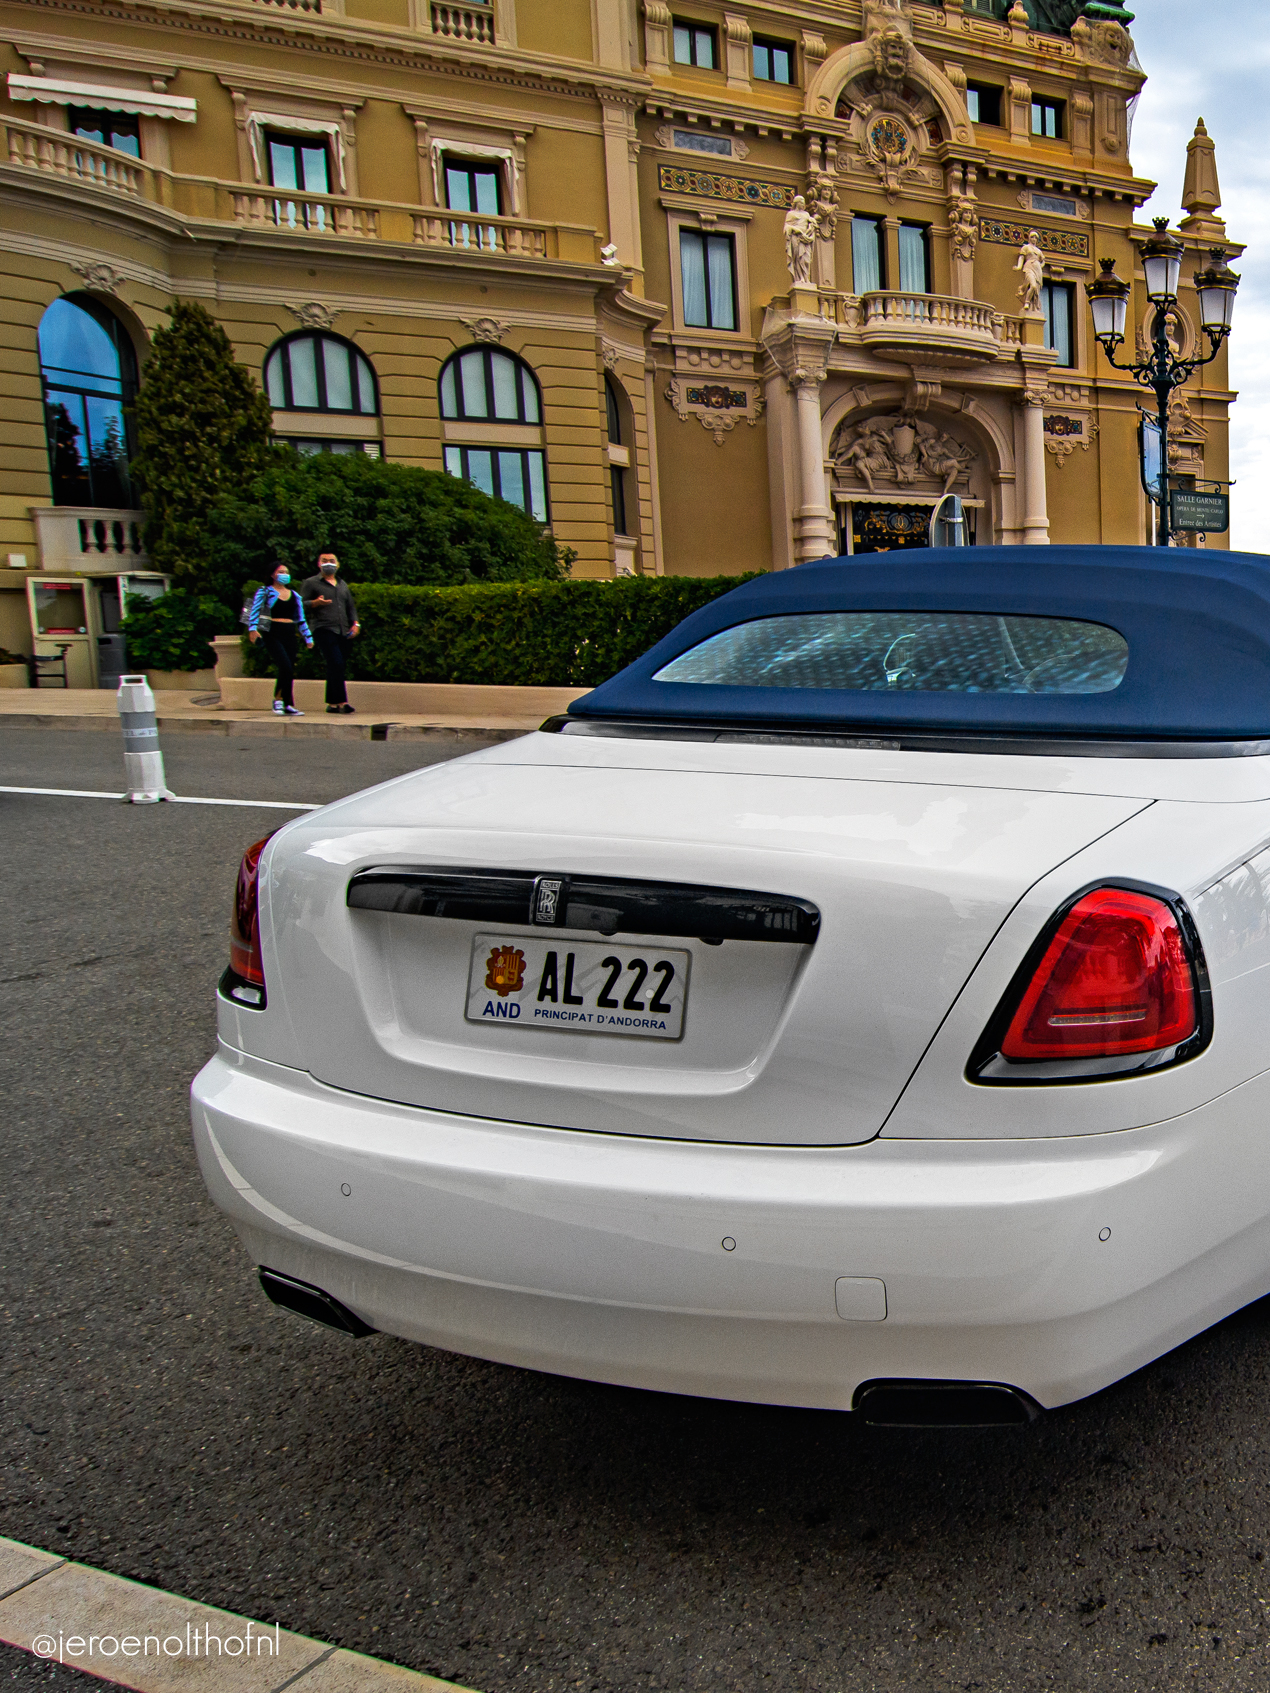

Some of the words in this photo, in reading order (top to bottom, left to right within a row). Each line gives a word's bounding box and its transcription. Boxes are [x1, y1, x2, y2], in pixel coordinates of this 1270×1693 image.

[1177, 495, 1195, 503] SALLE
[1196, 497, 1222, 505] GARNIER
[537, 951, 584, 1006] AL
[597, 956, 675, 1014] 222
[482, 1000, 521, 1019] AND
[534, 1008, 594, 1024] PRINCIPAT
[597, 1014, 667, 1030] D'ANDORRA
